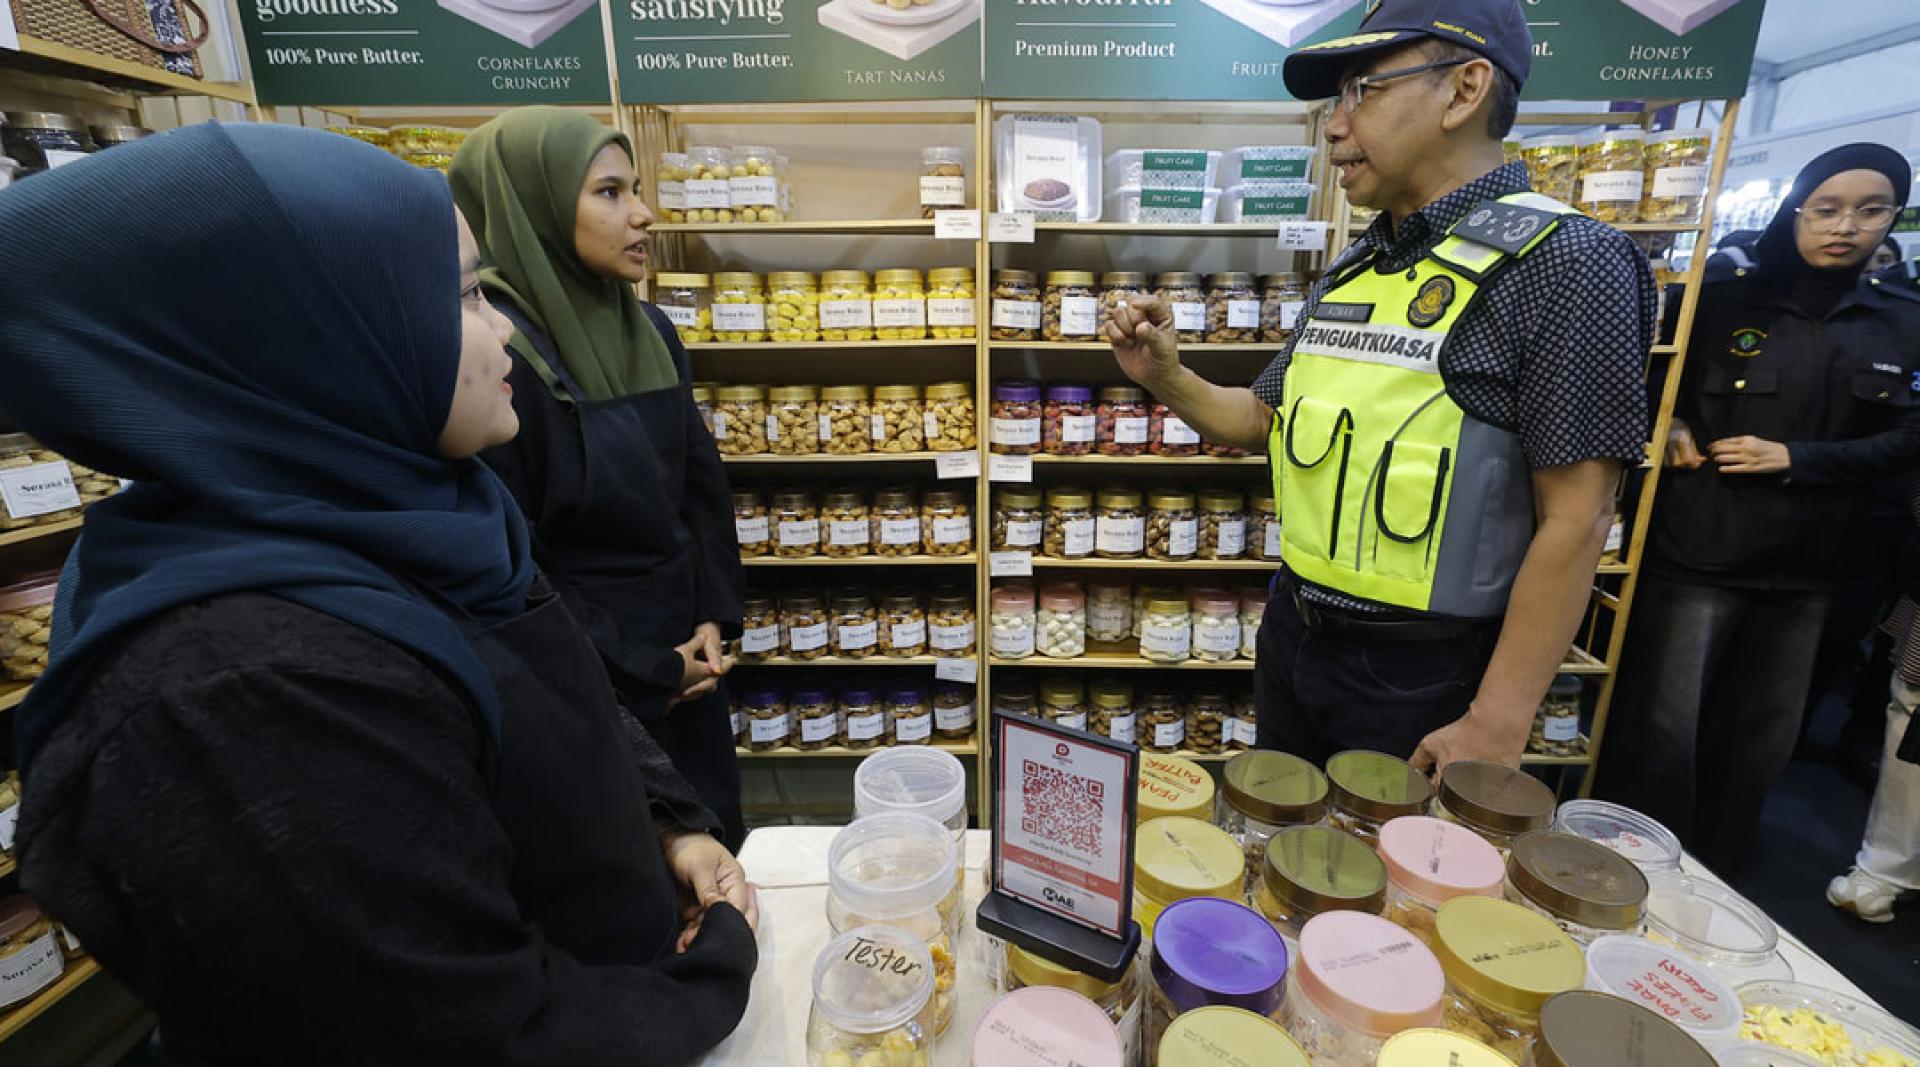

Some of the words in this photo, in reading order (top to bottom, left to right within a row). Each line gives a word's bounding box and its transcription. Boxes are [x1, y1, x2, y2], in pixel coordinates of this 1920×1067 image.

[266, 48, 312, 65] 100%
[316, 49, 359, 65] Pure
[362, 48, 424, 65] Butter.
[1015, 39, 1098, 57] Premium
[1103, 41, 1177, 58] Product
[1629, 45, 1693, 60] HONEY
[477, 56, 582, 71] CORNFLAKES
[636, 53, 682, 70] 100%
[686, 53, 728, 69] Pure
[732, 52, 794, 69] Butter.
[1231, 61, 1280, 76] FRUIT
[845, 69, 884, 84] TART
[890, 68, 946, 83] NANAS
[1600, 66, 1715, 81] CORNFLAKES
[492, 76, 571, 91] CRUNCHY
[1301, 327, 1435, 362] PENGUATKUASA
[844, 936, 922, 976] Tester
